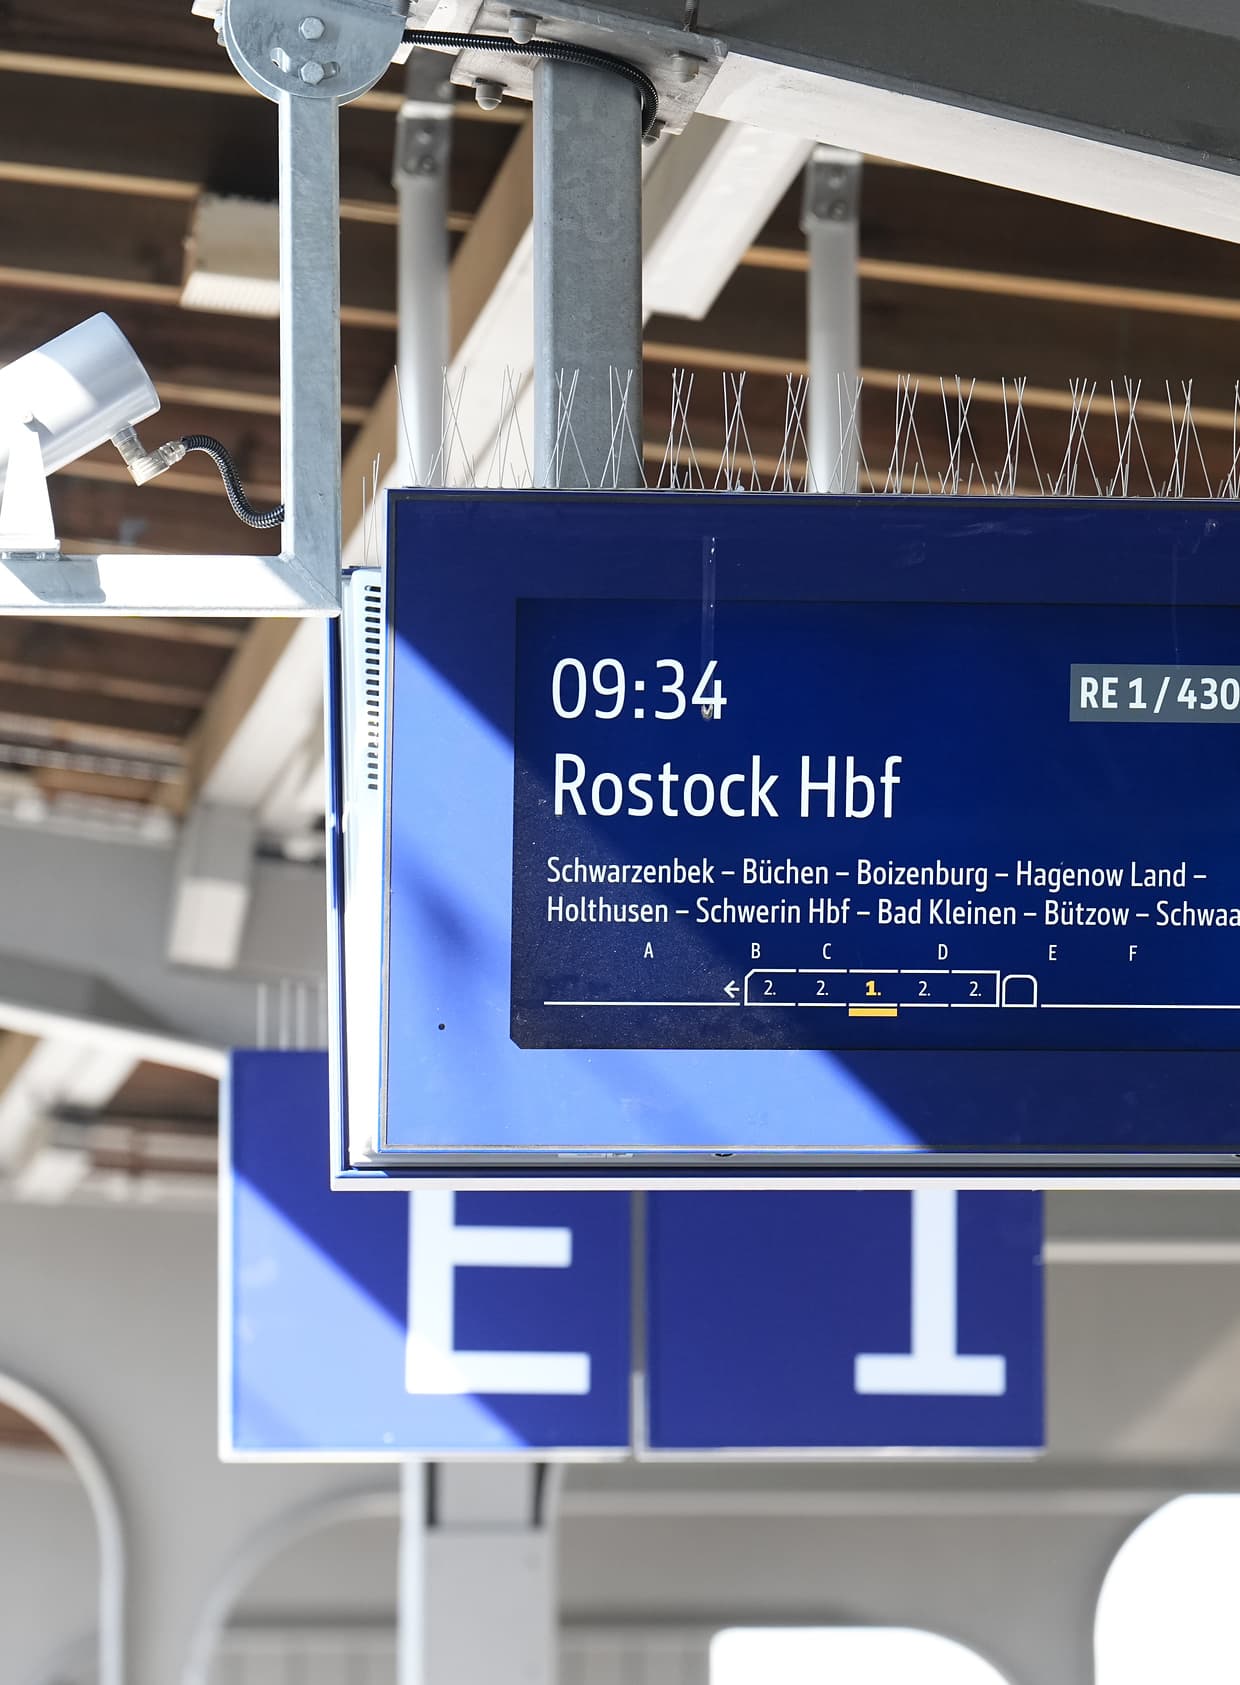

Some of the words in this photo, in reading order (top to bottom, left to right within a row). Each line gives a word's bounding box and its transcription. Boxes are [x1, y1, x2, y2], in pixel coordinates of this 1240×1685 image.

[552, 657, 728, 720] 09:34
[1080, 676, 1119, 709] RE
[554, 752, 779, 818] Rostock
[800, 755, 903, 819] Hbf
[547, 856, 715, 884] Schwarzenbek
[743, 857, 829, 885] Büchen
[857, 858, 988, 893] Boizenburg
[1016, 860, 1124, 893] Hagenow
[1131, 861, 1186, 888] Land
[547, 895, 668, 923] Holthusen
[696, 896, 801, 924] Schwerin
[808, 897, 851, 924] Hbf
[878, 898, 922, 925] Bad
[929, 898, 1016, 925] Kleinen
[1045, 899, 1130, 926] Bützow
[643, 941, 654, 959] A
[751, 942, 761, 959] B
[822, 942, 832, 960] C
[938, 943, 949, 961] D
[1048, 944, 1058, 961] E
[1129, 944, 1138, 962] F
[763, 979, 777, 996] 2.
[816, 979, 829, 996] 2.
[865, 980, 882, 996] 1.
[918, 980, 931, 997] 2.
[969, 980, 982, 997] 2.
[405, 1190, 592, 1395] E
